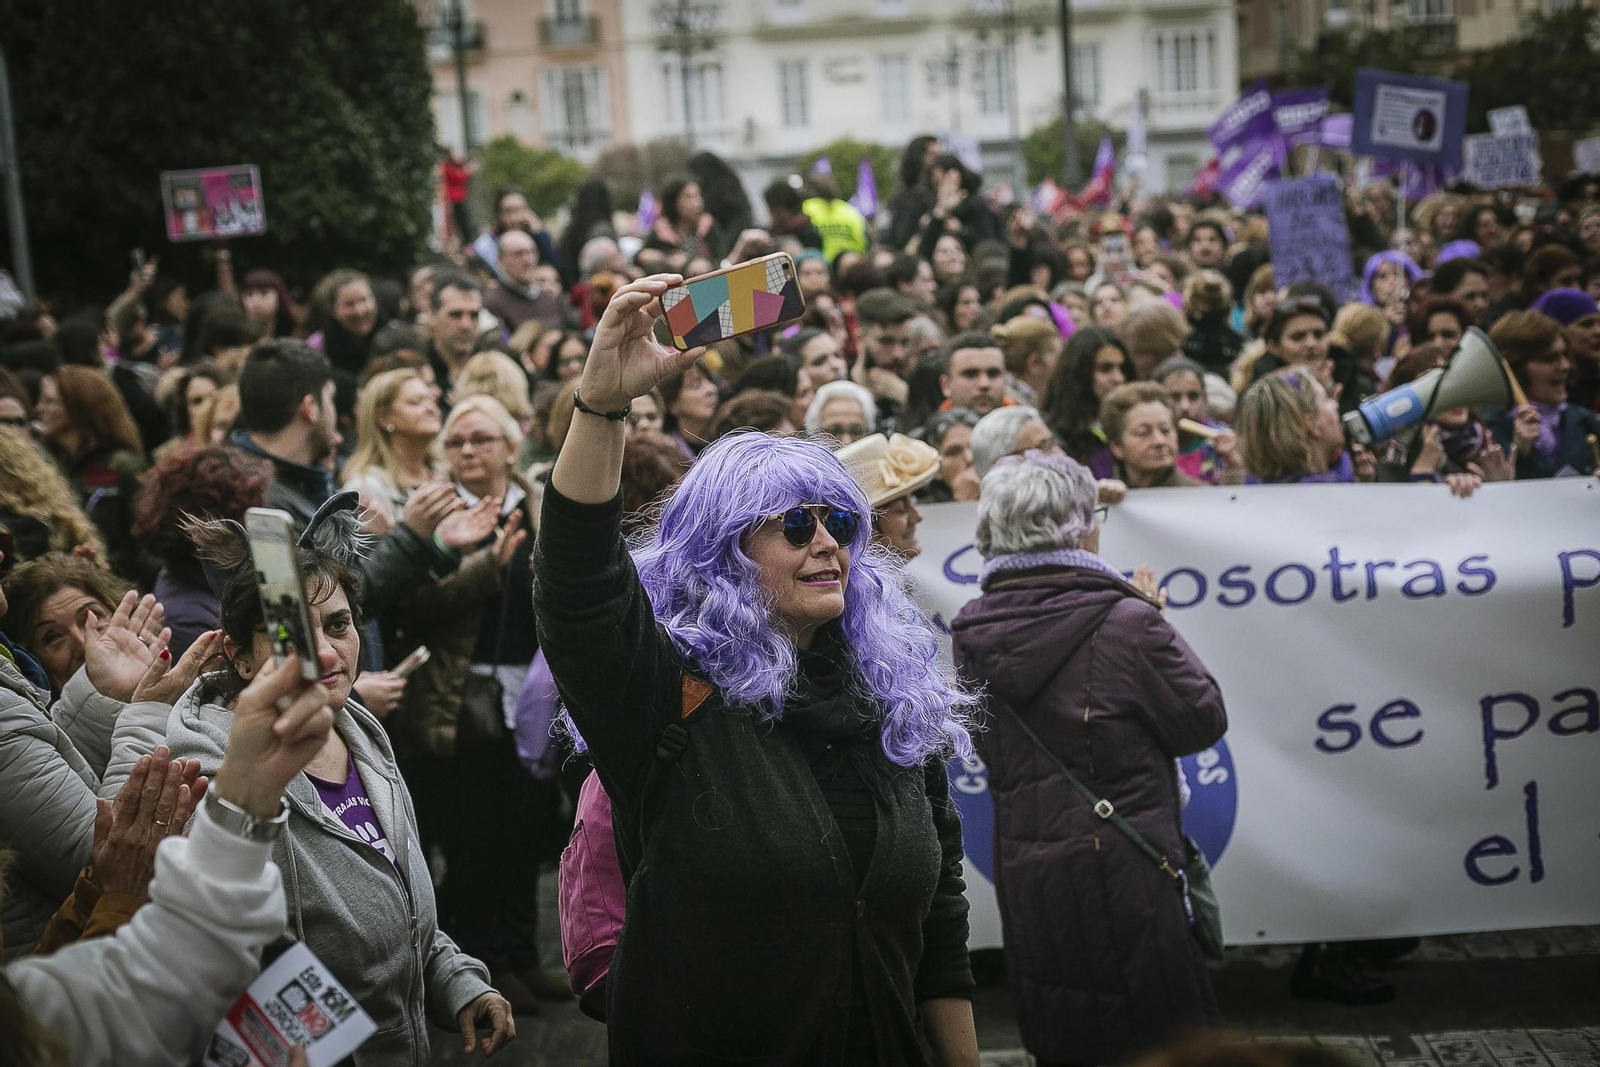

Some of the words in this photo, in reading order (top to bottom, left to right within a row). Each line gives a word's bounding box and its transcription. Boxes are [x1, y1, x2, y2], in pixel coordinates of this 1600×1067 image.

[1122, 546, 1497, 609] osotras
[1314, 697, 1424, 754] se
[1464, 779, 1545, 887] el
